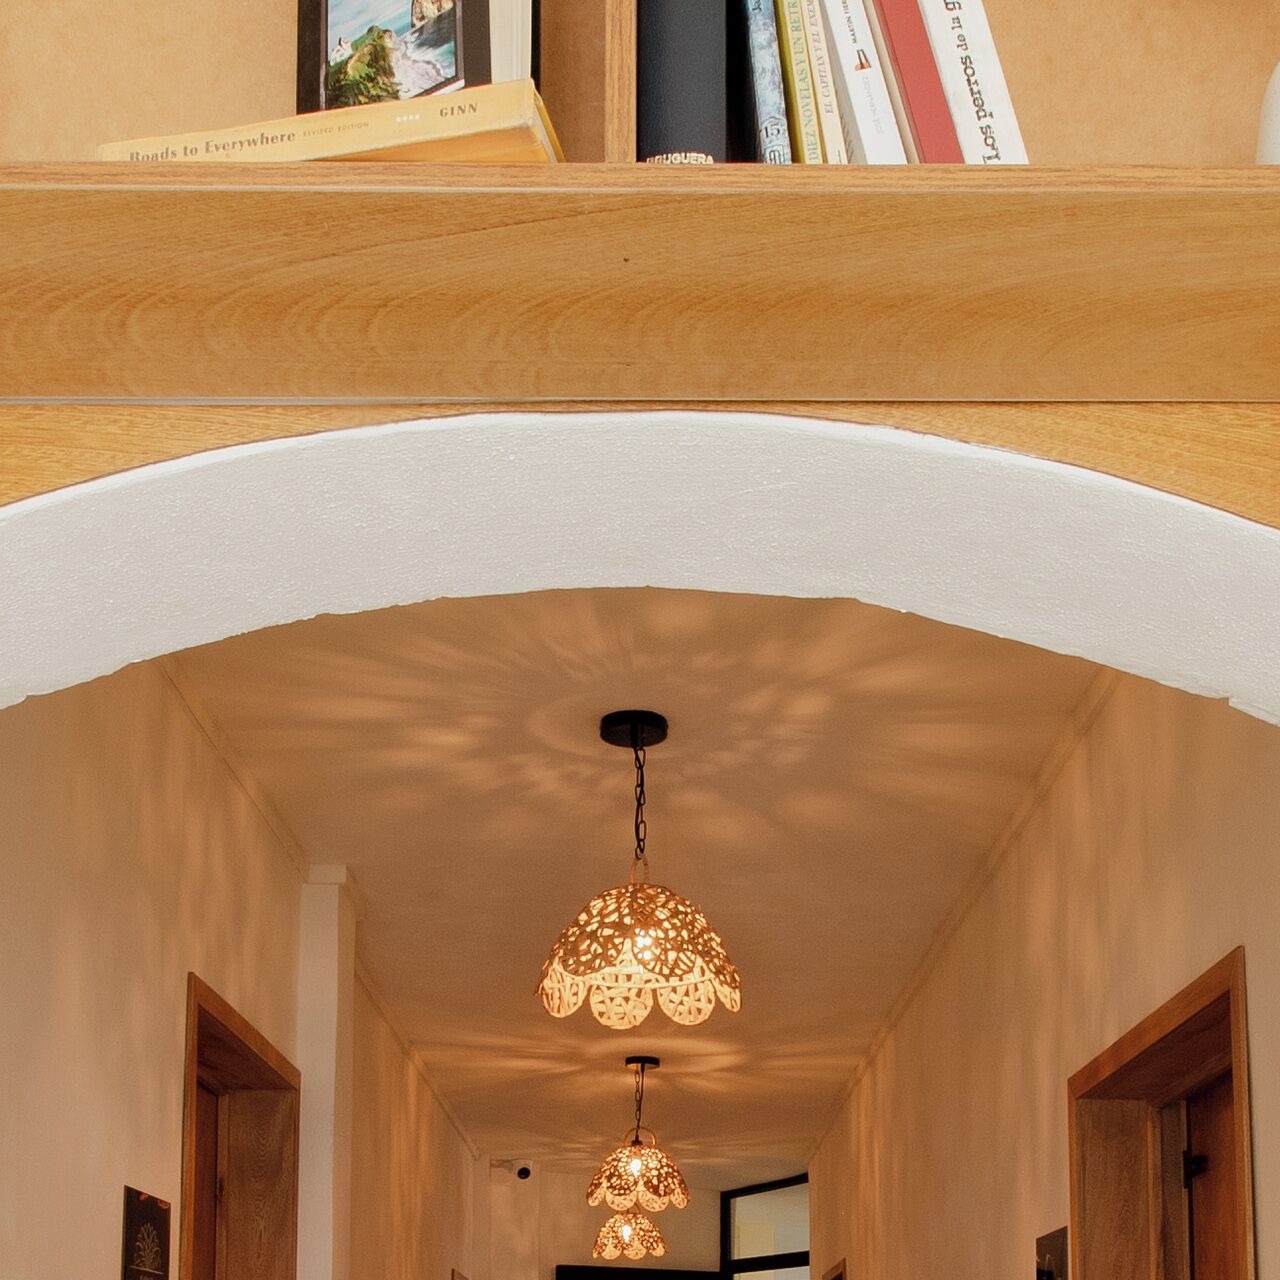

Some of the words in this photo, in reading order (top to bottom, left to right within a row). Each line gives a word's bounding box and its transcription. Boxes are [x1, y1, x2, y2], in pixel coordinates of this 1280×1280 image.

[951, 16, 963, 31] la
[791, 36, 803, 57] UN
[811, 31, 822, 43] EL
[956, 34, 969, 52] de
[797, 69, 817, 127] NOVELAS
[960, 55, 994, 122] perros
[438, 102, 479, 119] GINN
[824, 102, 834, 114] EL
[129, 147, 178, 162] Roads
[183, 145, 199, 157] to
[204, 130, 297, 154] Everywhere
[805, 130, 820, 163] DIEZ
[979, 124, 1001, 164] Los
